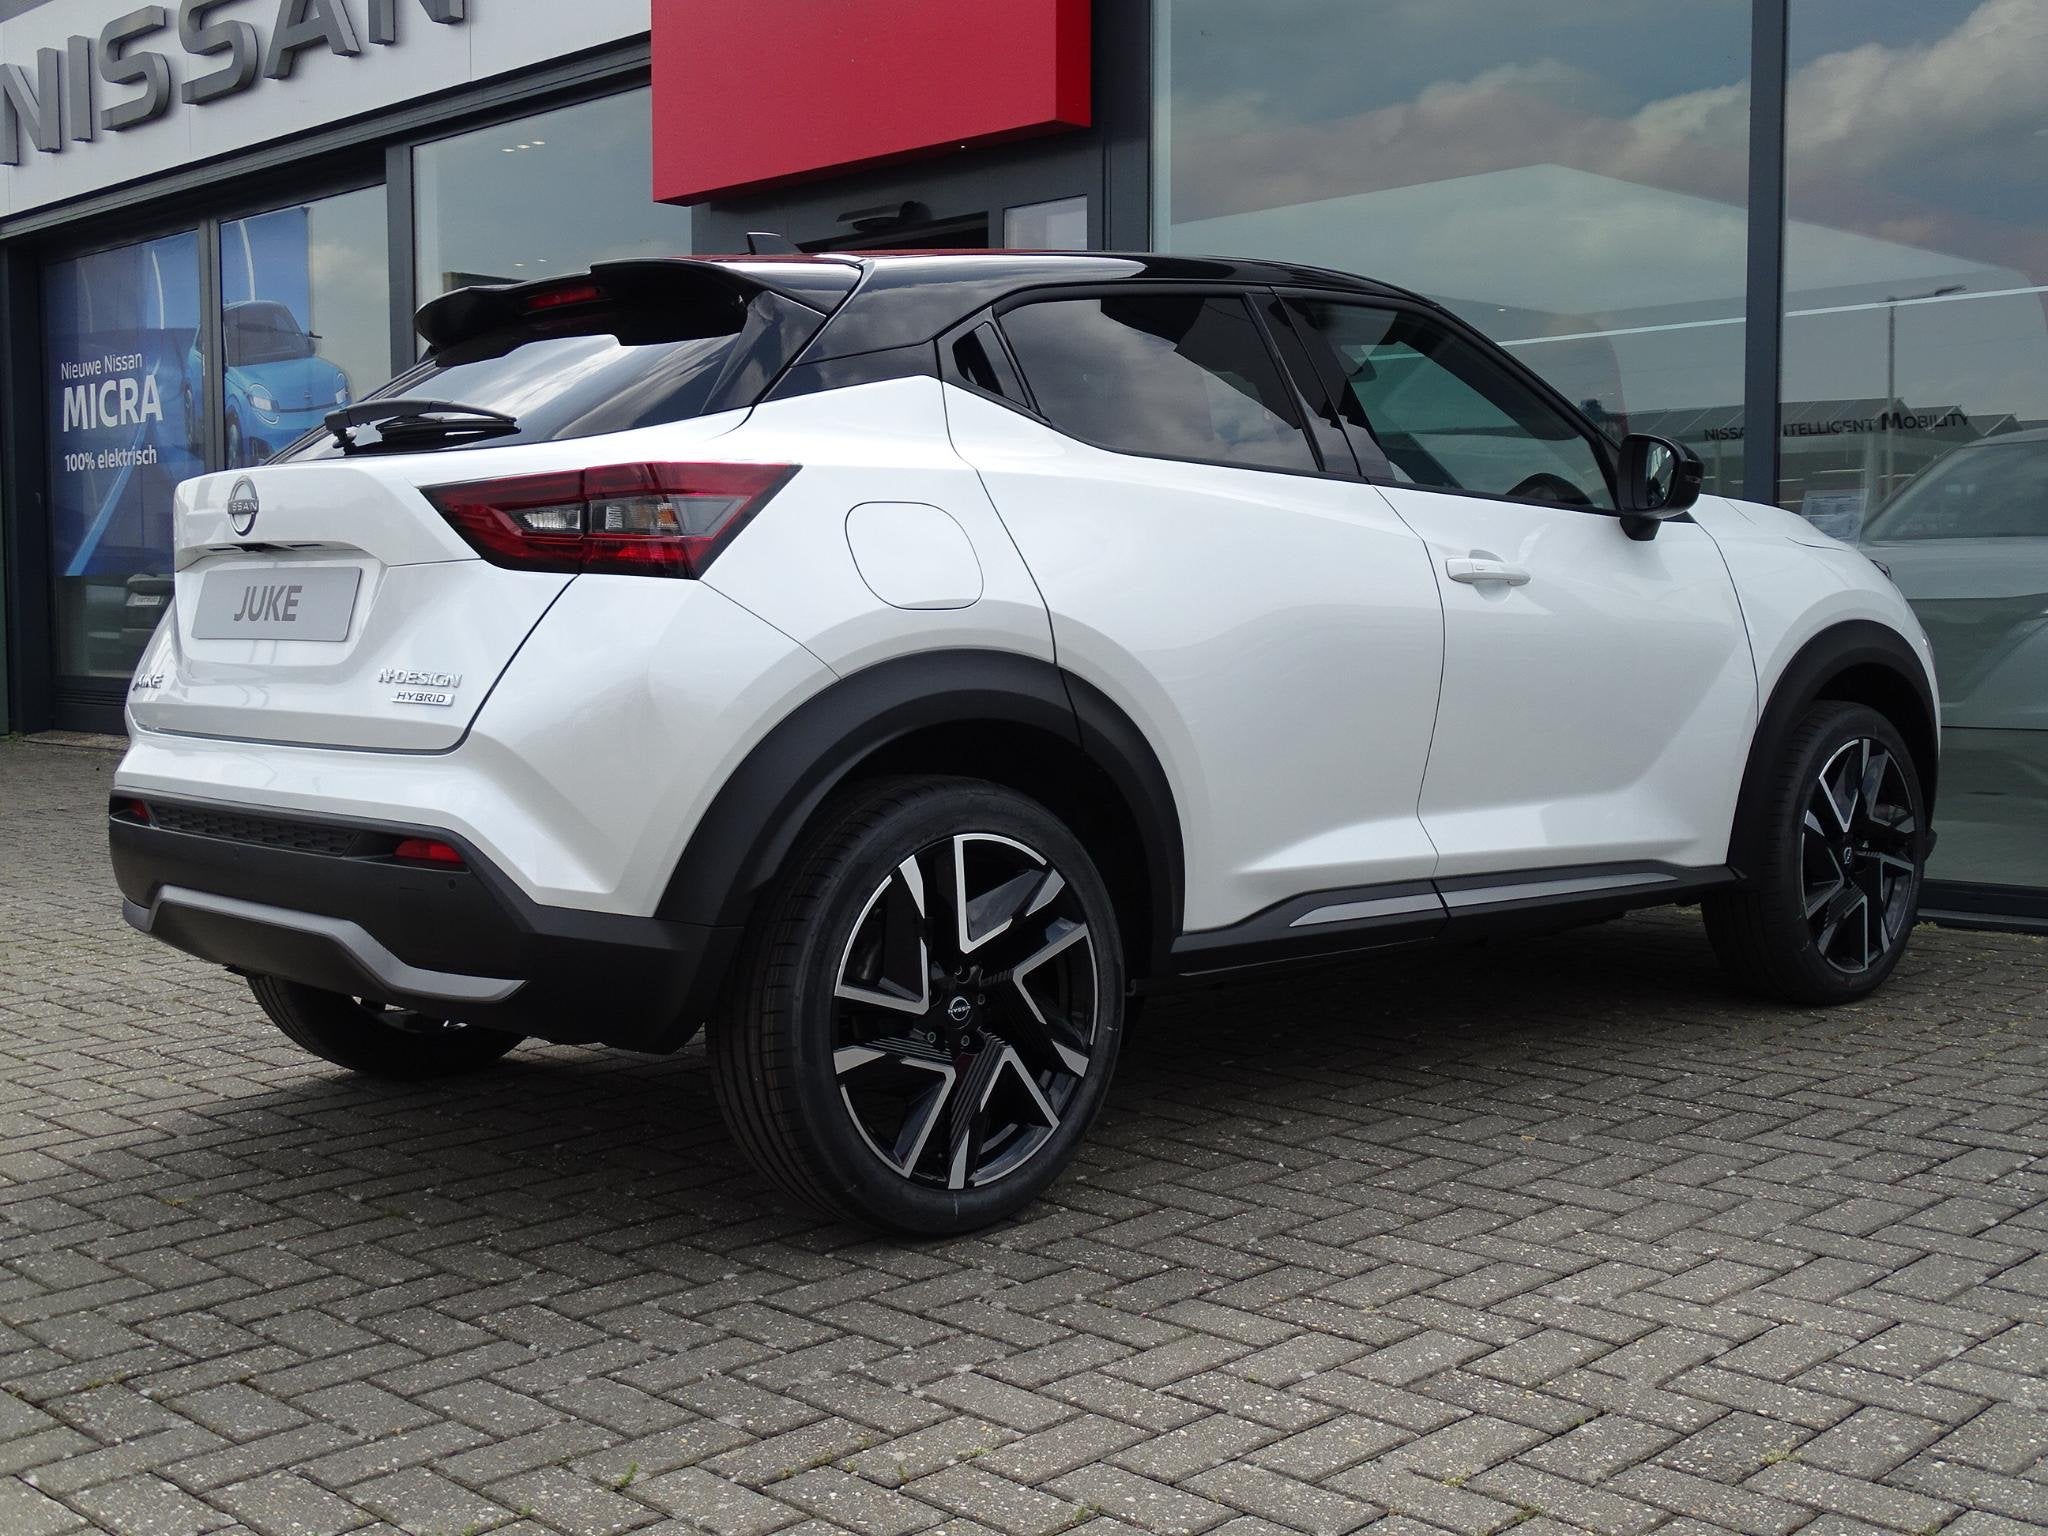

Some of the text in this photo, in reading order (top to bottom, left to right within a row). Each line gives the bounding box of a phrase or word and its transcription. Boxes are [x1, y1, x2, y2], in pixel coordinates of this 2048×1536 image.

[61, 353, 143, 380] Nieuwe Nissan
[63, 374, 163, 432] MICRA
[1703, 411, 1969, 441] NISSA TELLIGENT MOBILITY
[65, 444, 157, 472] 100% elektrisch
[233, 585, 303, 622] JUKE
[378, 668, 463, 688] N-DESIGN
[396, 691, 446, 703] HYBRID
